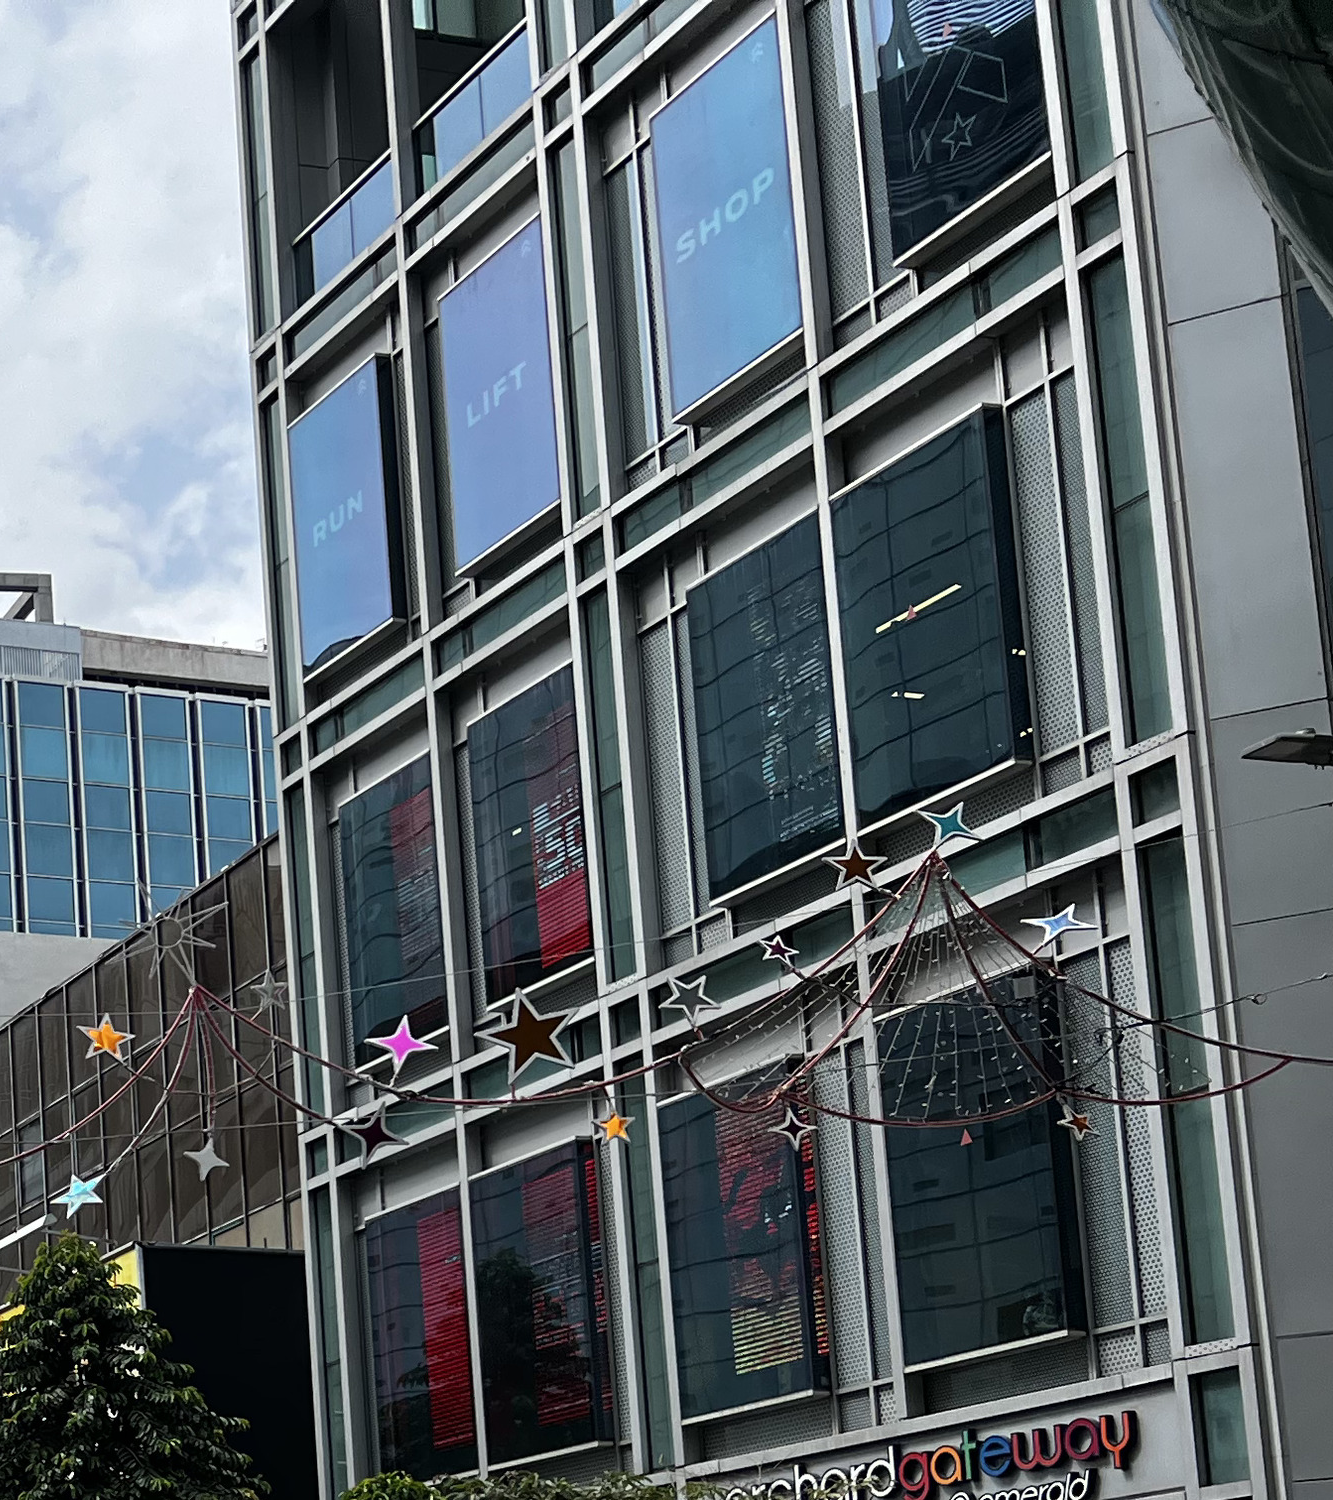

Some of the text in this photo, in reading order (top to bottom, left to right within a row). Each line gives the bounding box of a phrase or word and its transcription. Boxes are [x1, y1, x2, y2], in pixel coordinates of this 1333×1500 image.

[676, 167, 774, 264] SHOP
[466, 361, 526, 428] LIFT
[313, 490, 363, 547] RUN
